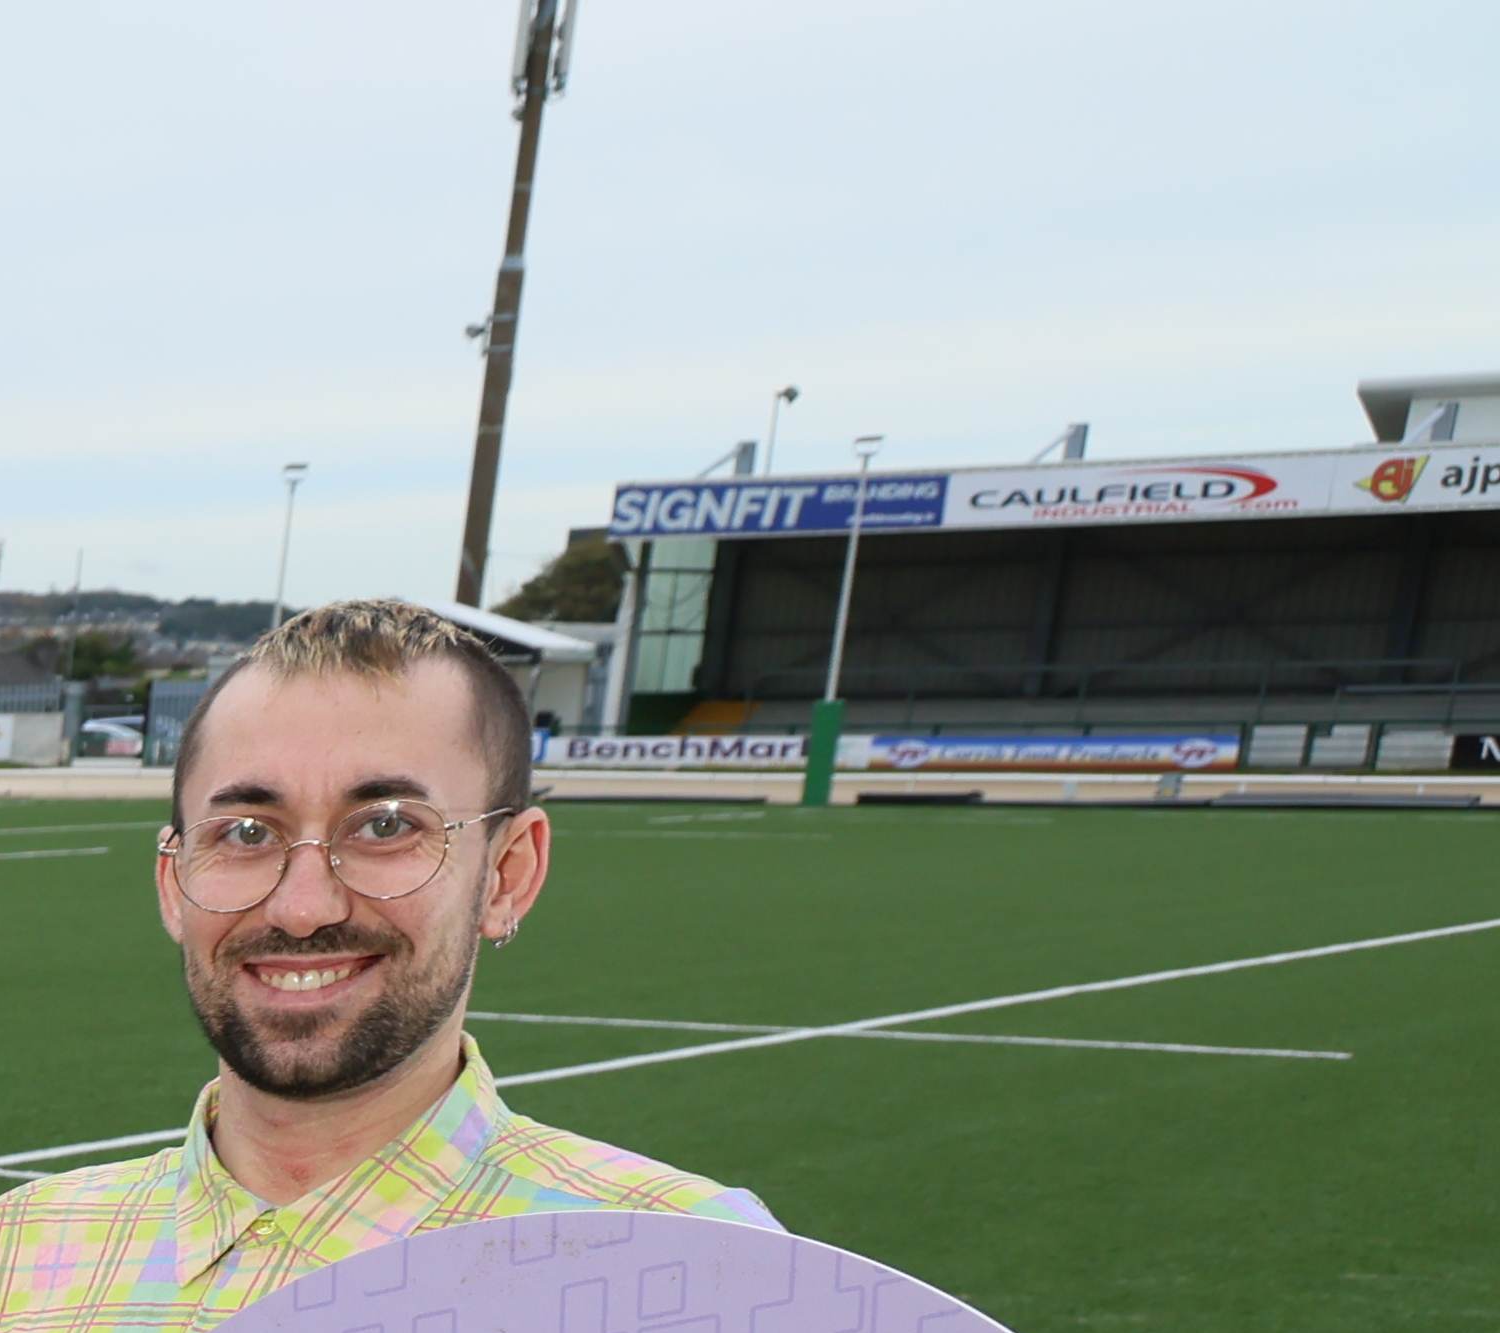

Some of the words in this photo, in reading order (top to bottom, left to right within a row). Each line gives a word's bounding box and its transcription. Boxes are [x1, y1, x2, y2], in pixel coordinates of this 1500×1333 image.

[970, 478, 1235, 508] CAULFIELD
[609, 486, 817, 533] SIGNFIT
[566, 737, 813, 760] BenchMar
